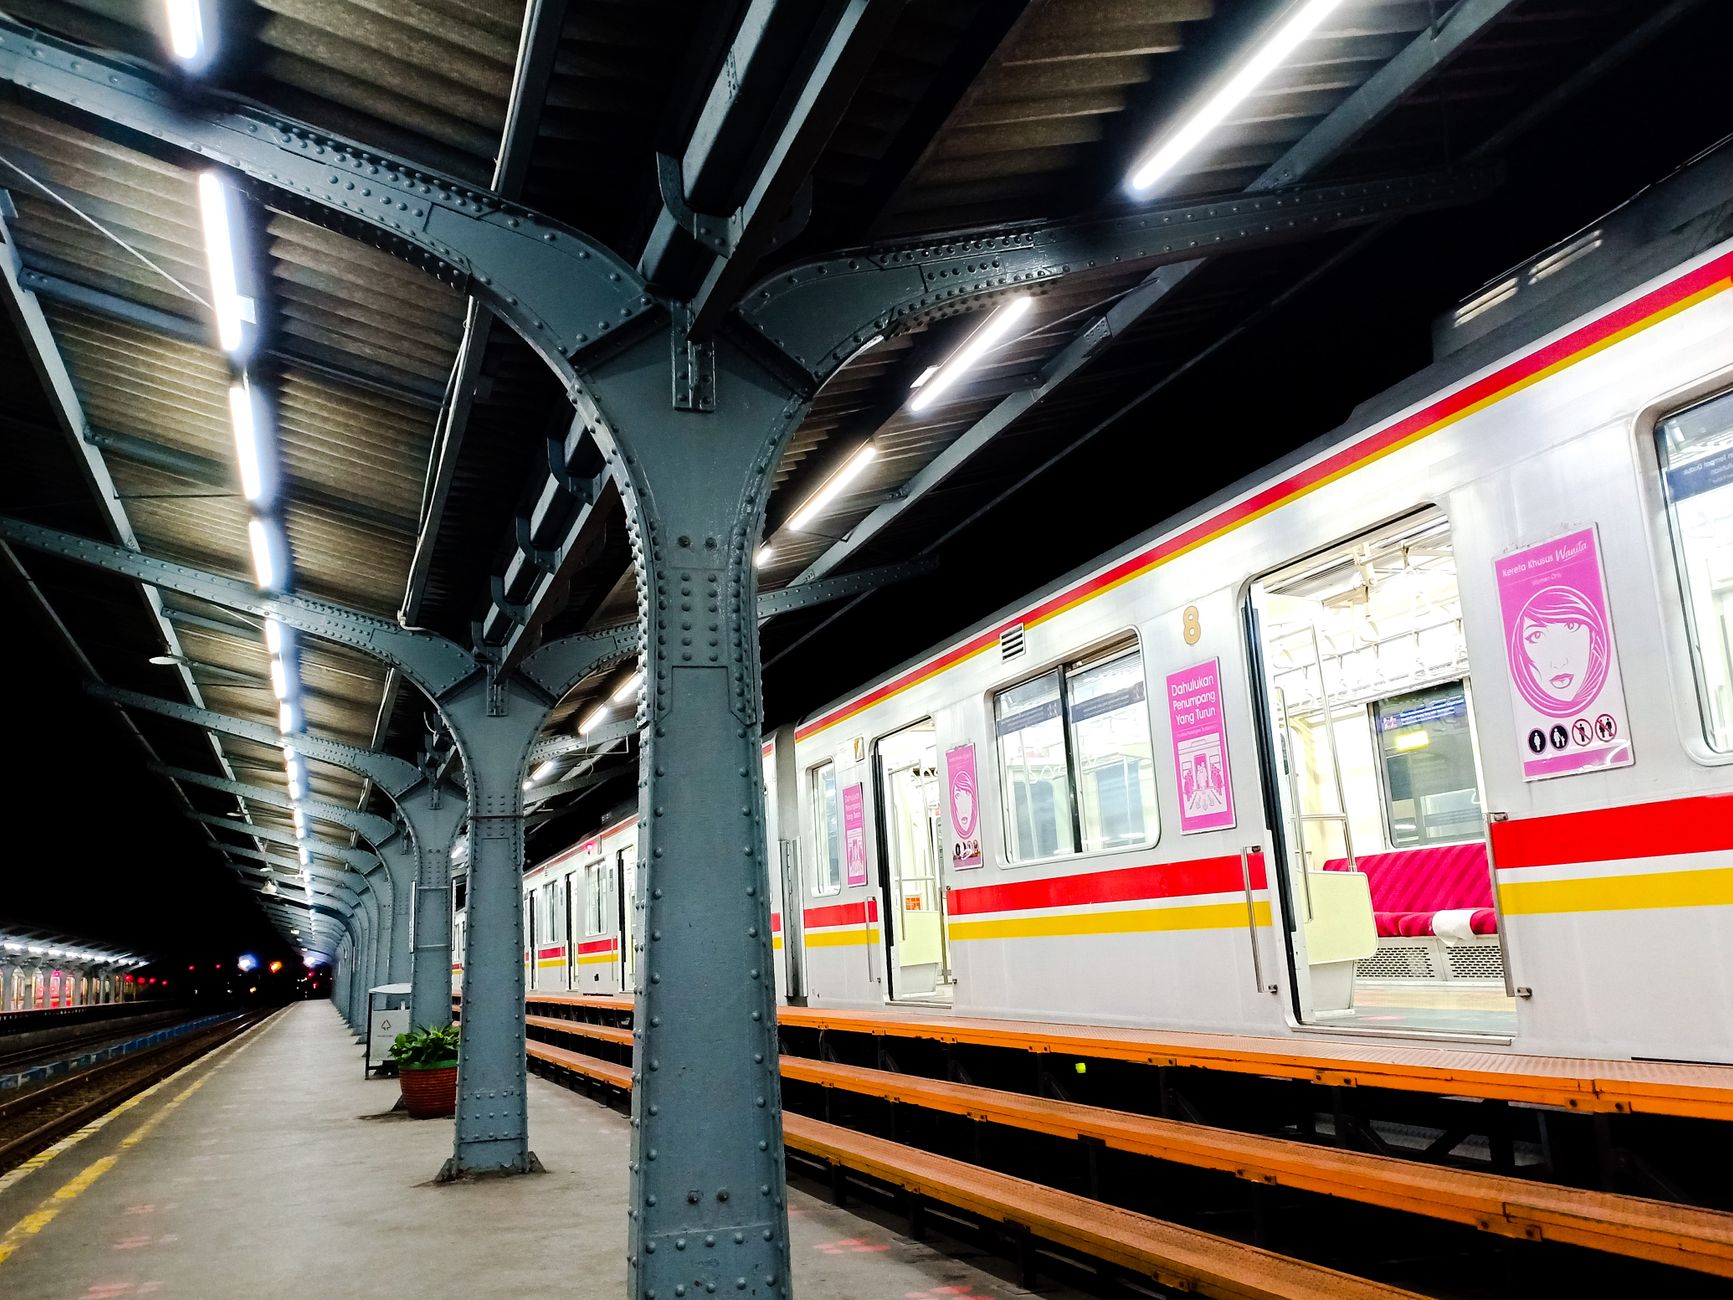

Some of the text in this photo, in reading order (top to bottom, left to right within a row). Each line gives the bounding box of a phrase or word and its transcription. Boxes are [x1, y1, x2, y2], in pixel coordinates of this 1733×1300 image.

[1502, 540, 1587, 577] Kereta Khusus Wanita
[1183, 605, 1201, 645] 8
[1171, 674, 1214, 697] Dahulukan
[1172, 690, 1216, 711] Penumpang
[1175, 706, 1216, 725] Yang Turun
